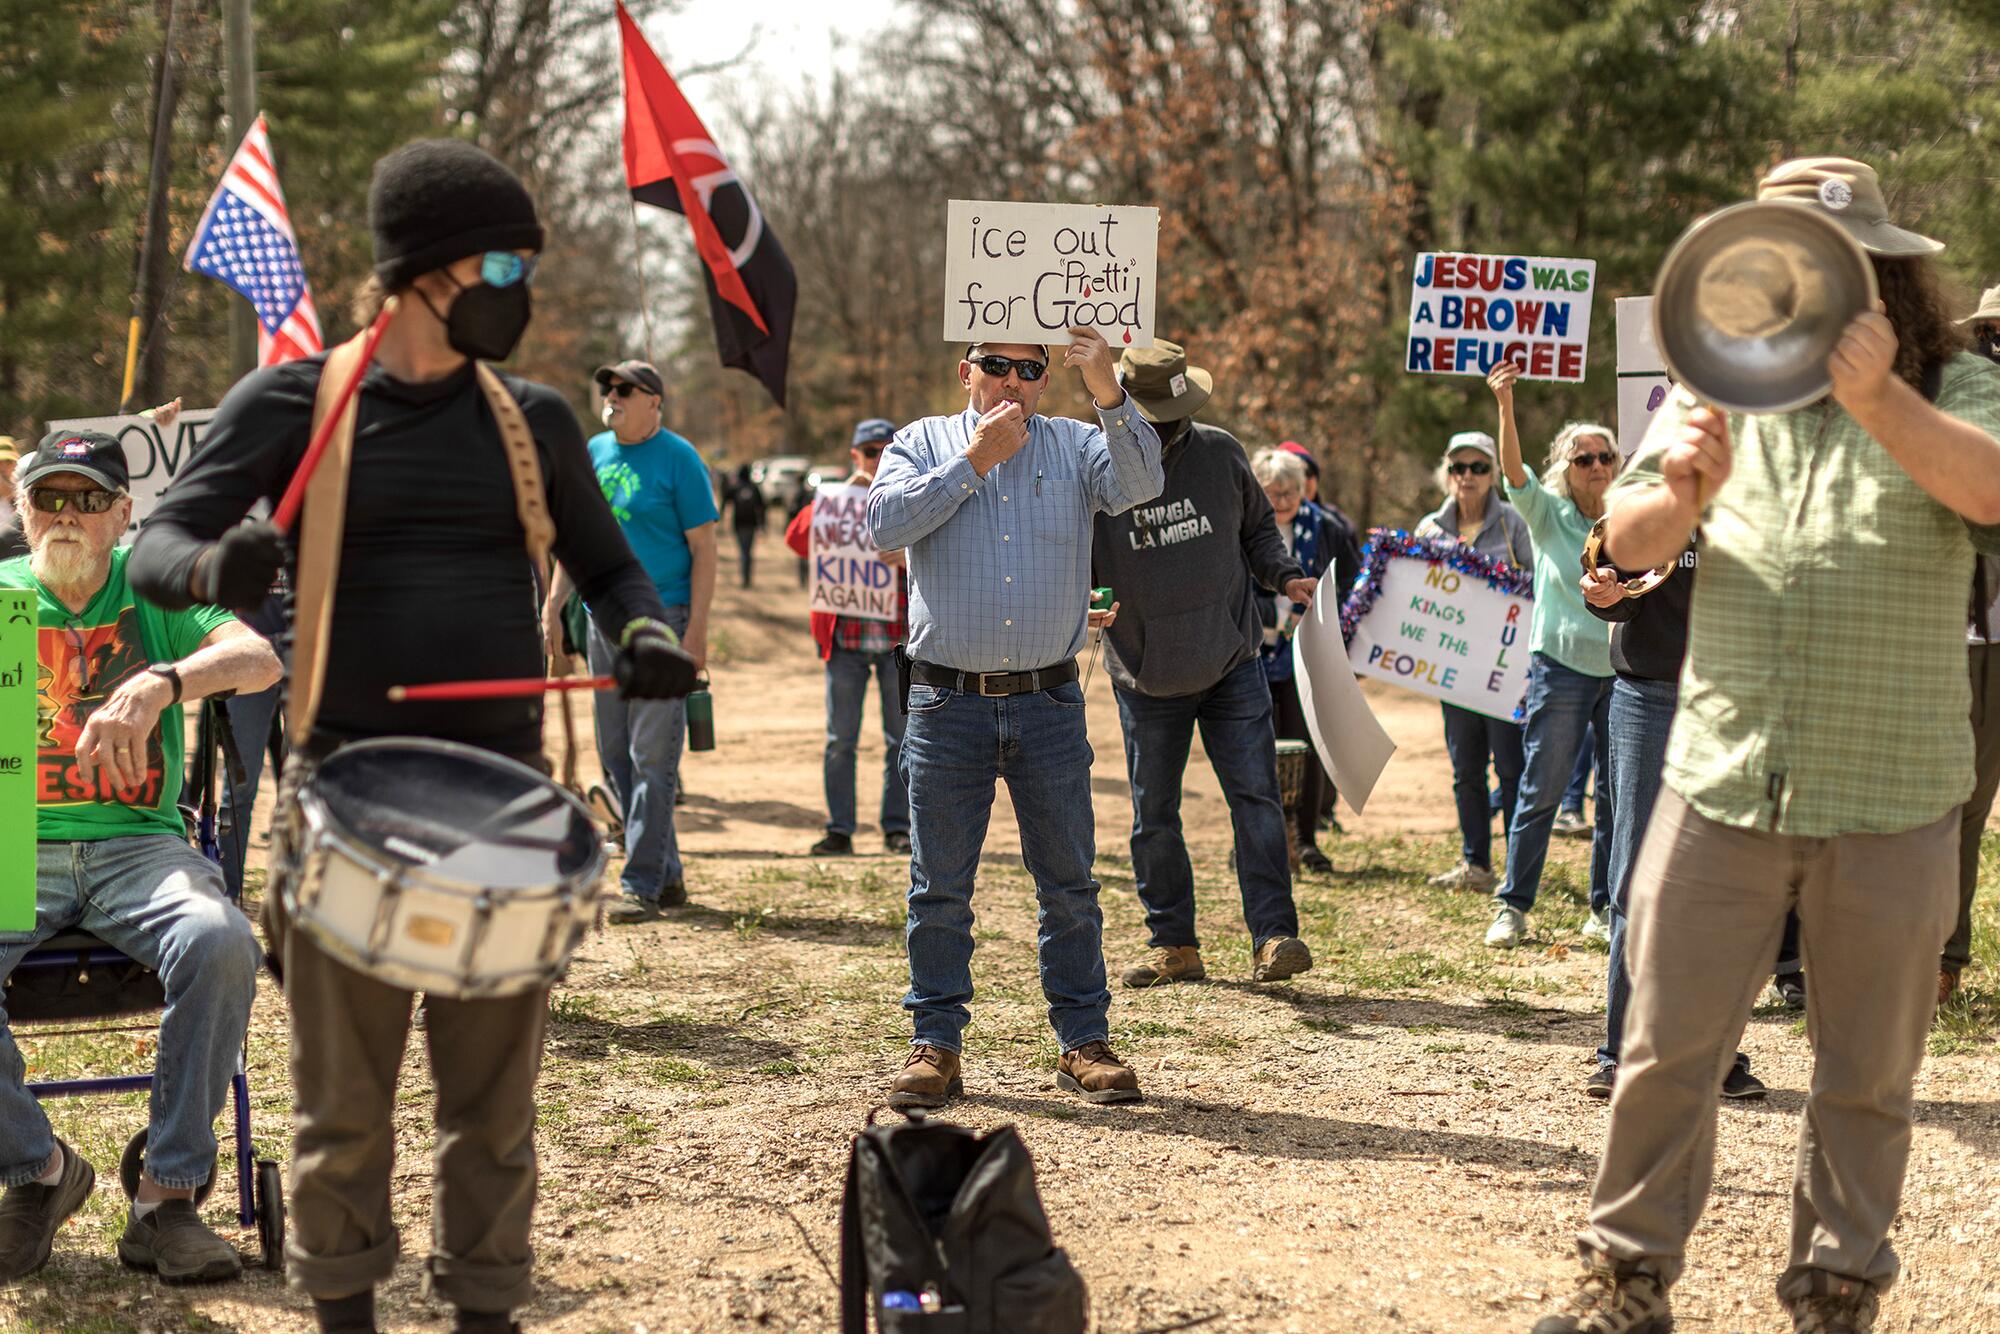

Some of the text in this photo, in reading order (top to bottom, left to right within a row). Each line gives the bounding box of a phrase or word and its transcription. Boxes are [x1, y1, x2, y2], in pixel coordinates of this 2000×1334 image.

[972, 213, 1119, 259] ice out
[1415, 254, 1590, 292] JESUS WAS
[958, 271, 1142, 331] for Good
[1414, 295, 1571, 337] A BROWN
[1408, 336, 1583, 379] REFUGEE
[1128, 515, 1214, 551] LA MIGRA
[816, 555, 892, 590] KIND
[1424, 565, 1461, 594] NO
[812, 584, 895, 617] AGAIN!
[1409, 595, 1466, 626] KINGS
[1400, 621, 1470, 657] WE THE
[1486, 603, 1521, 693] RULE
[1367, 643, 1459, 690] PEOPLE
